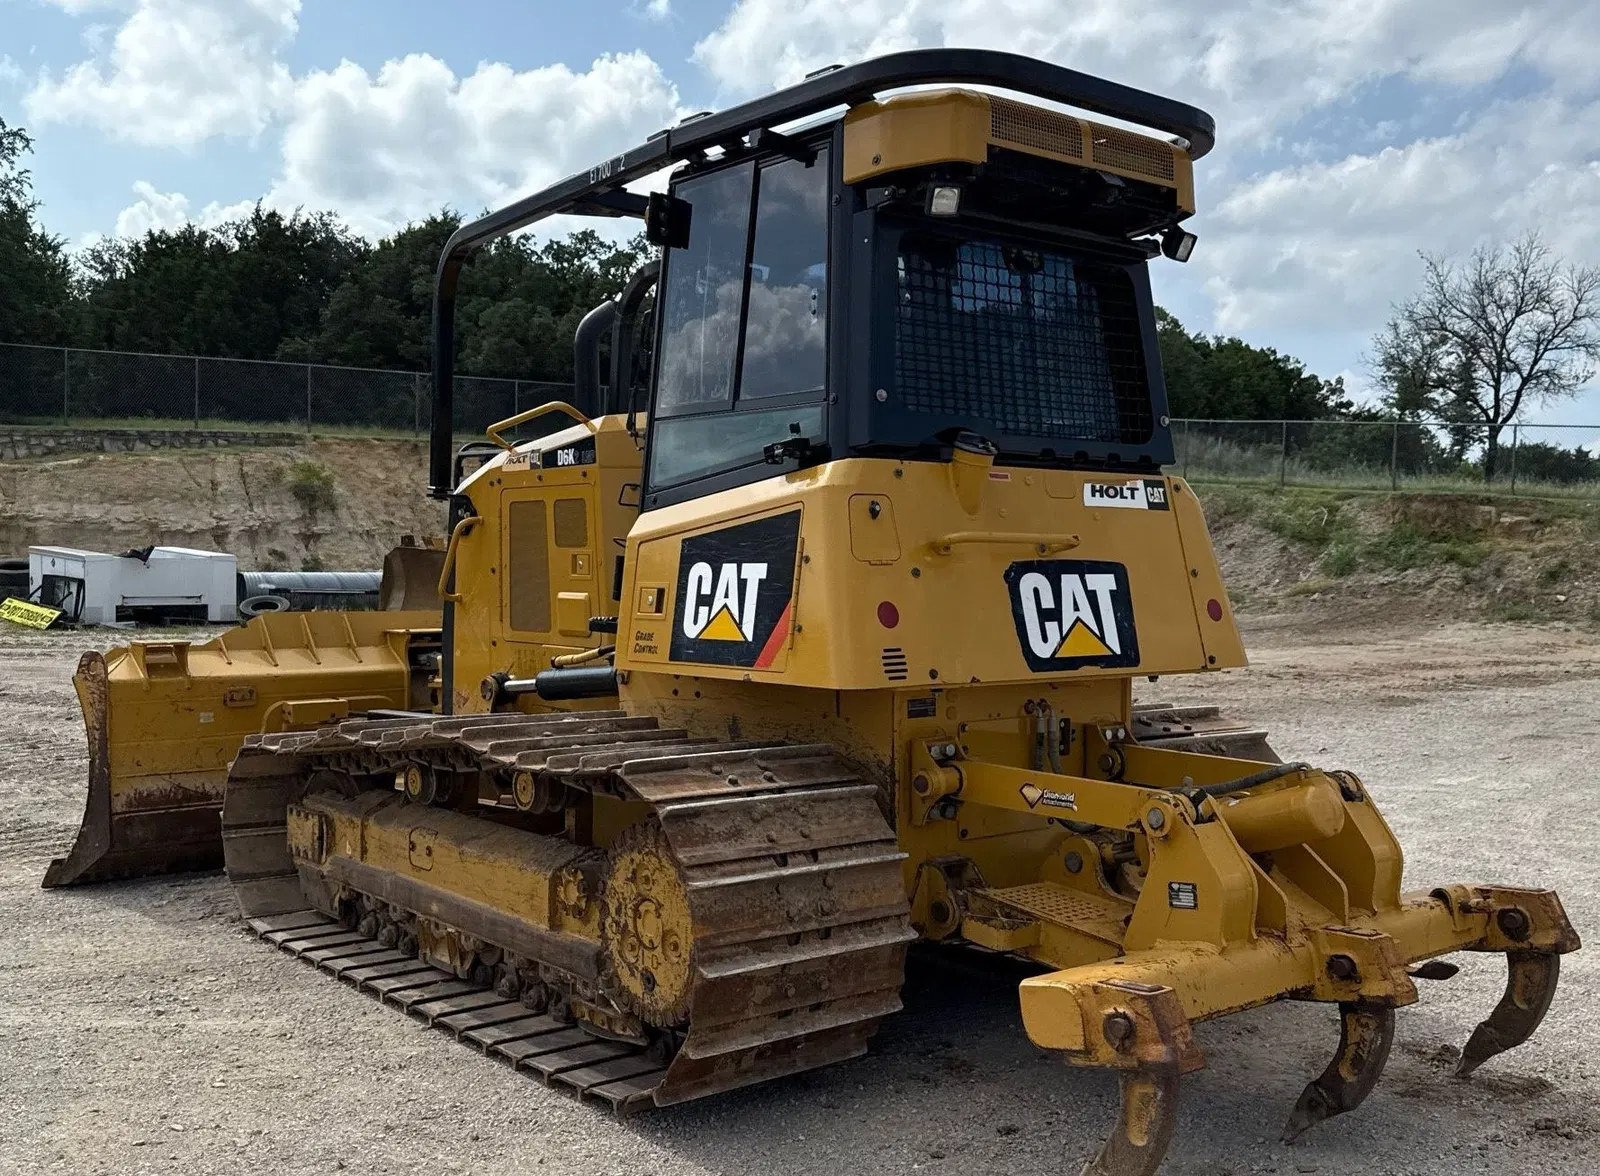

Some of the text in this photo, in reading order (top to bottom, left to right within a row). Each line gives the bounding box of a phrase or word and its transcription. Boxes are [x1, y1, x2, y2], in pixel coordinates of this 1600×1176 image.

[1090, 485, 1165, 503] HOLT CAT
[683, 562, 768, 642] CAT
[1019, 572, 1121, 658] CAT
[1043, 789, 1075, 802] Diamond
